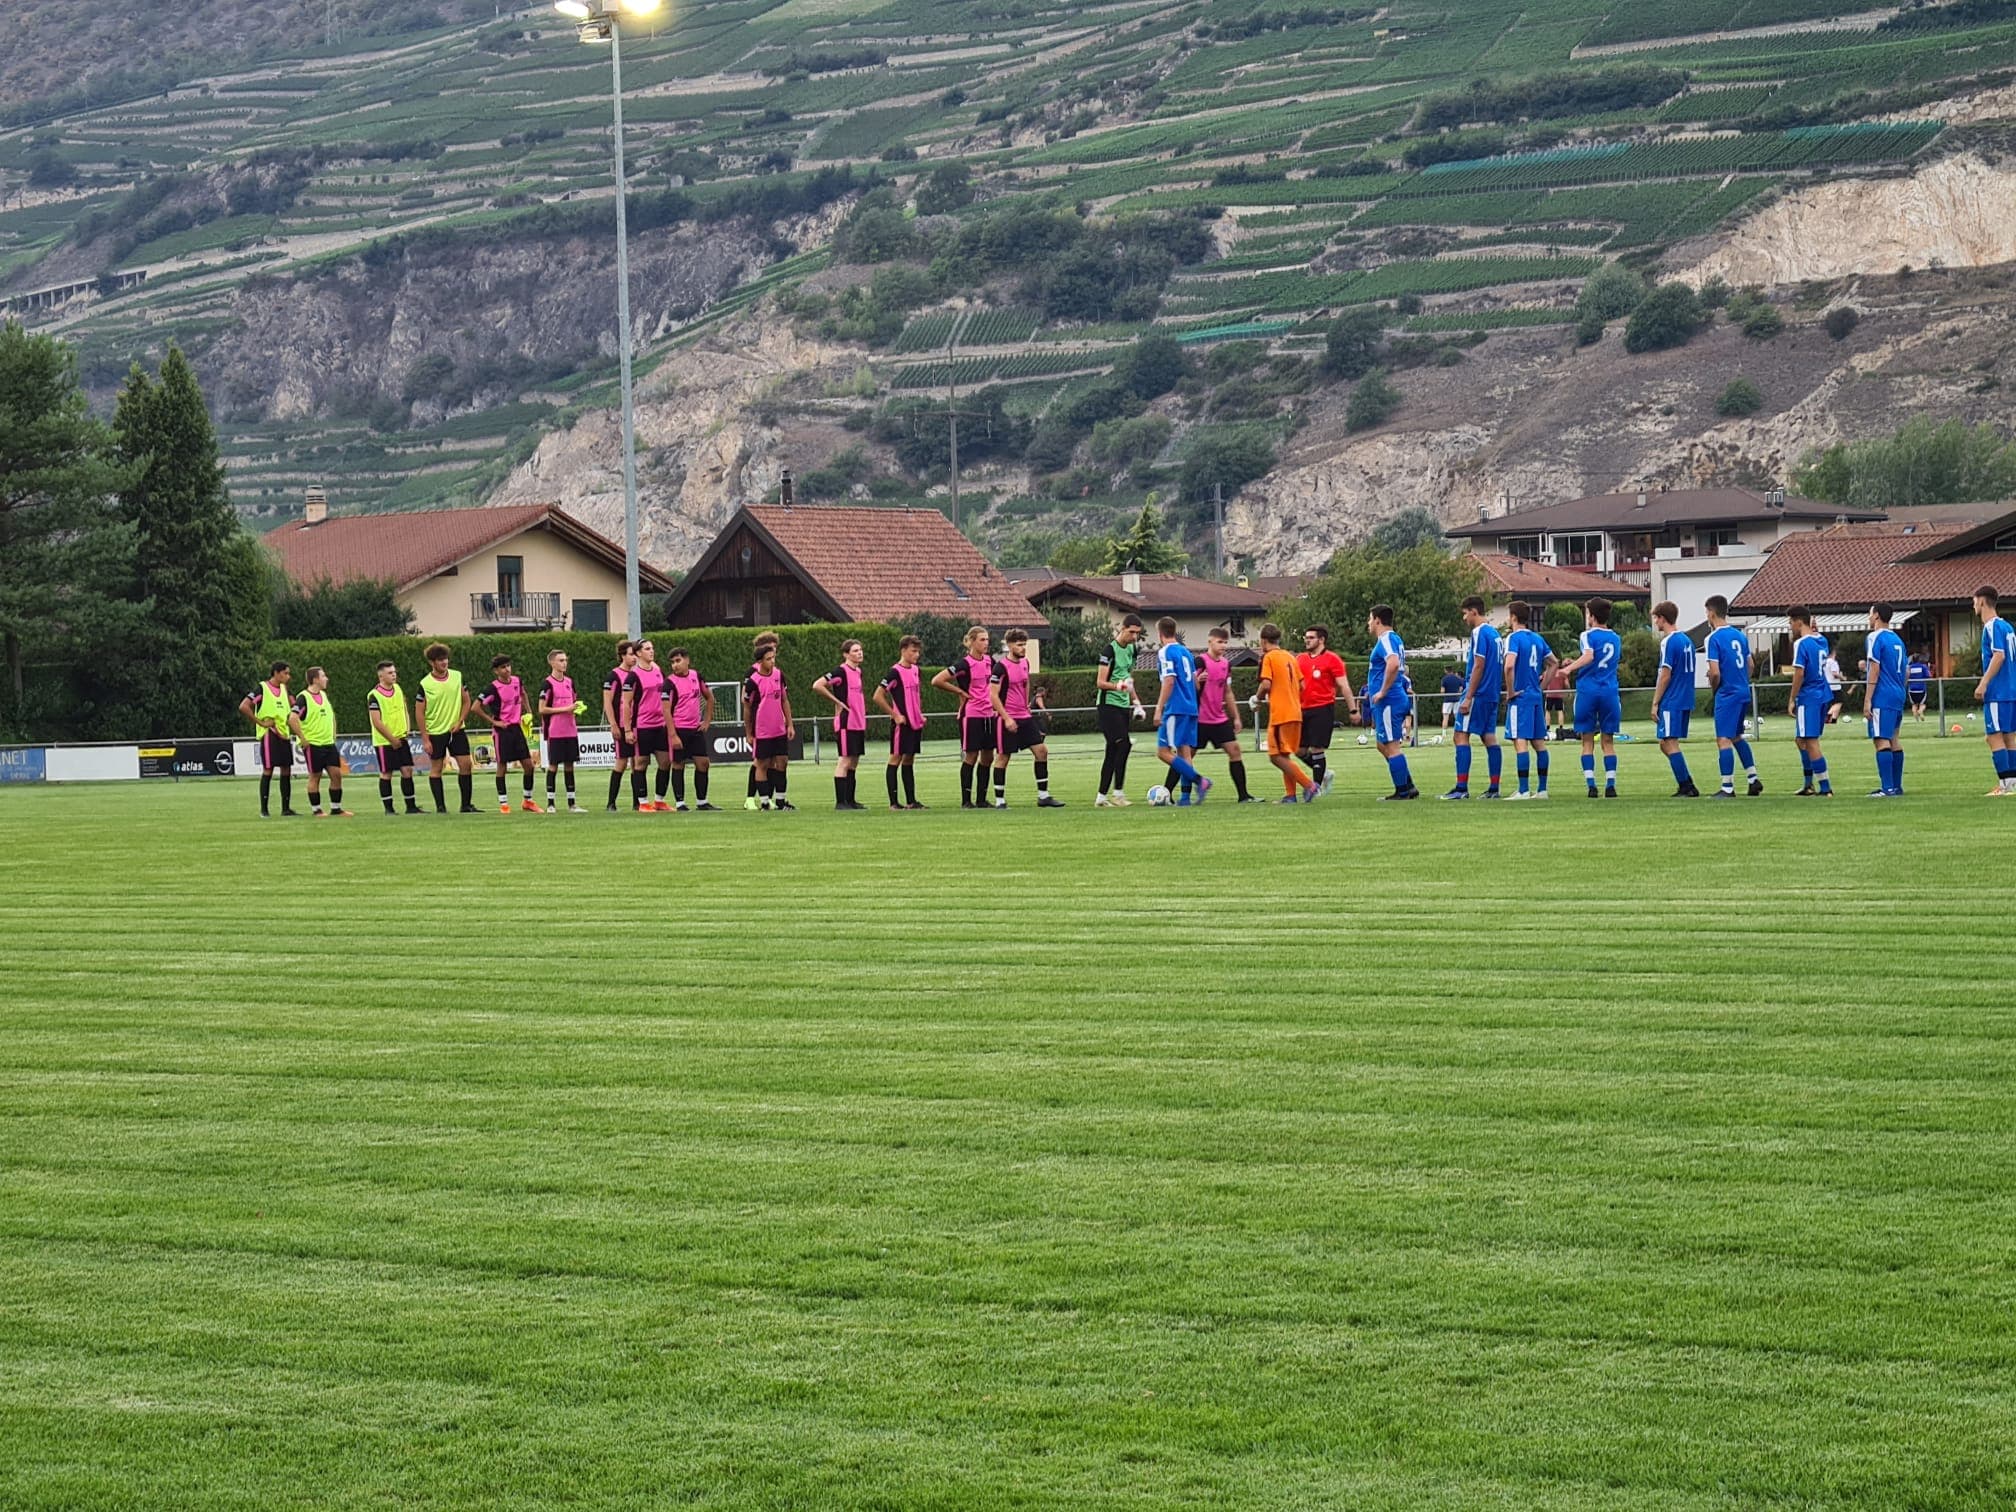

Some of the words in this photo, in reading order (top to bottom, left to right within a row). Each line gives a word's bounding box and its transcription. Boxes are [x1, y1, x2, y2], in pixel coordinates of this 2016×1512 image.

[1529, 644, 1538, 671] 4
[1598, 642, 1614, 668] 2
[1683, 645, 1694, 673] 11
[1731, 639, 1745, 669] 3
[1894, 644, 1903, 673] 7
[1182, 655, 1192, 682] 9
[0, 750, 27, 766] NET
[181, 761, 204, 772] atlas
